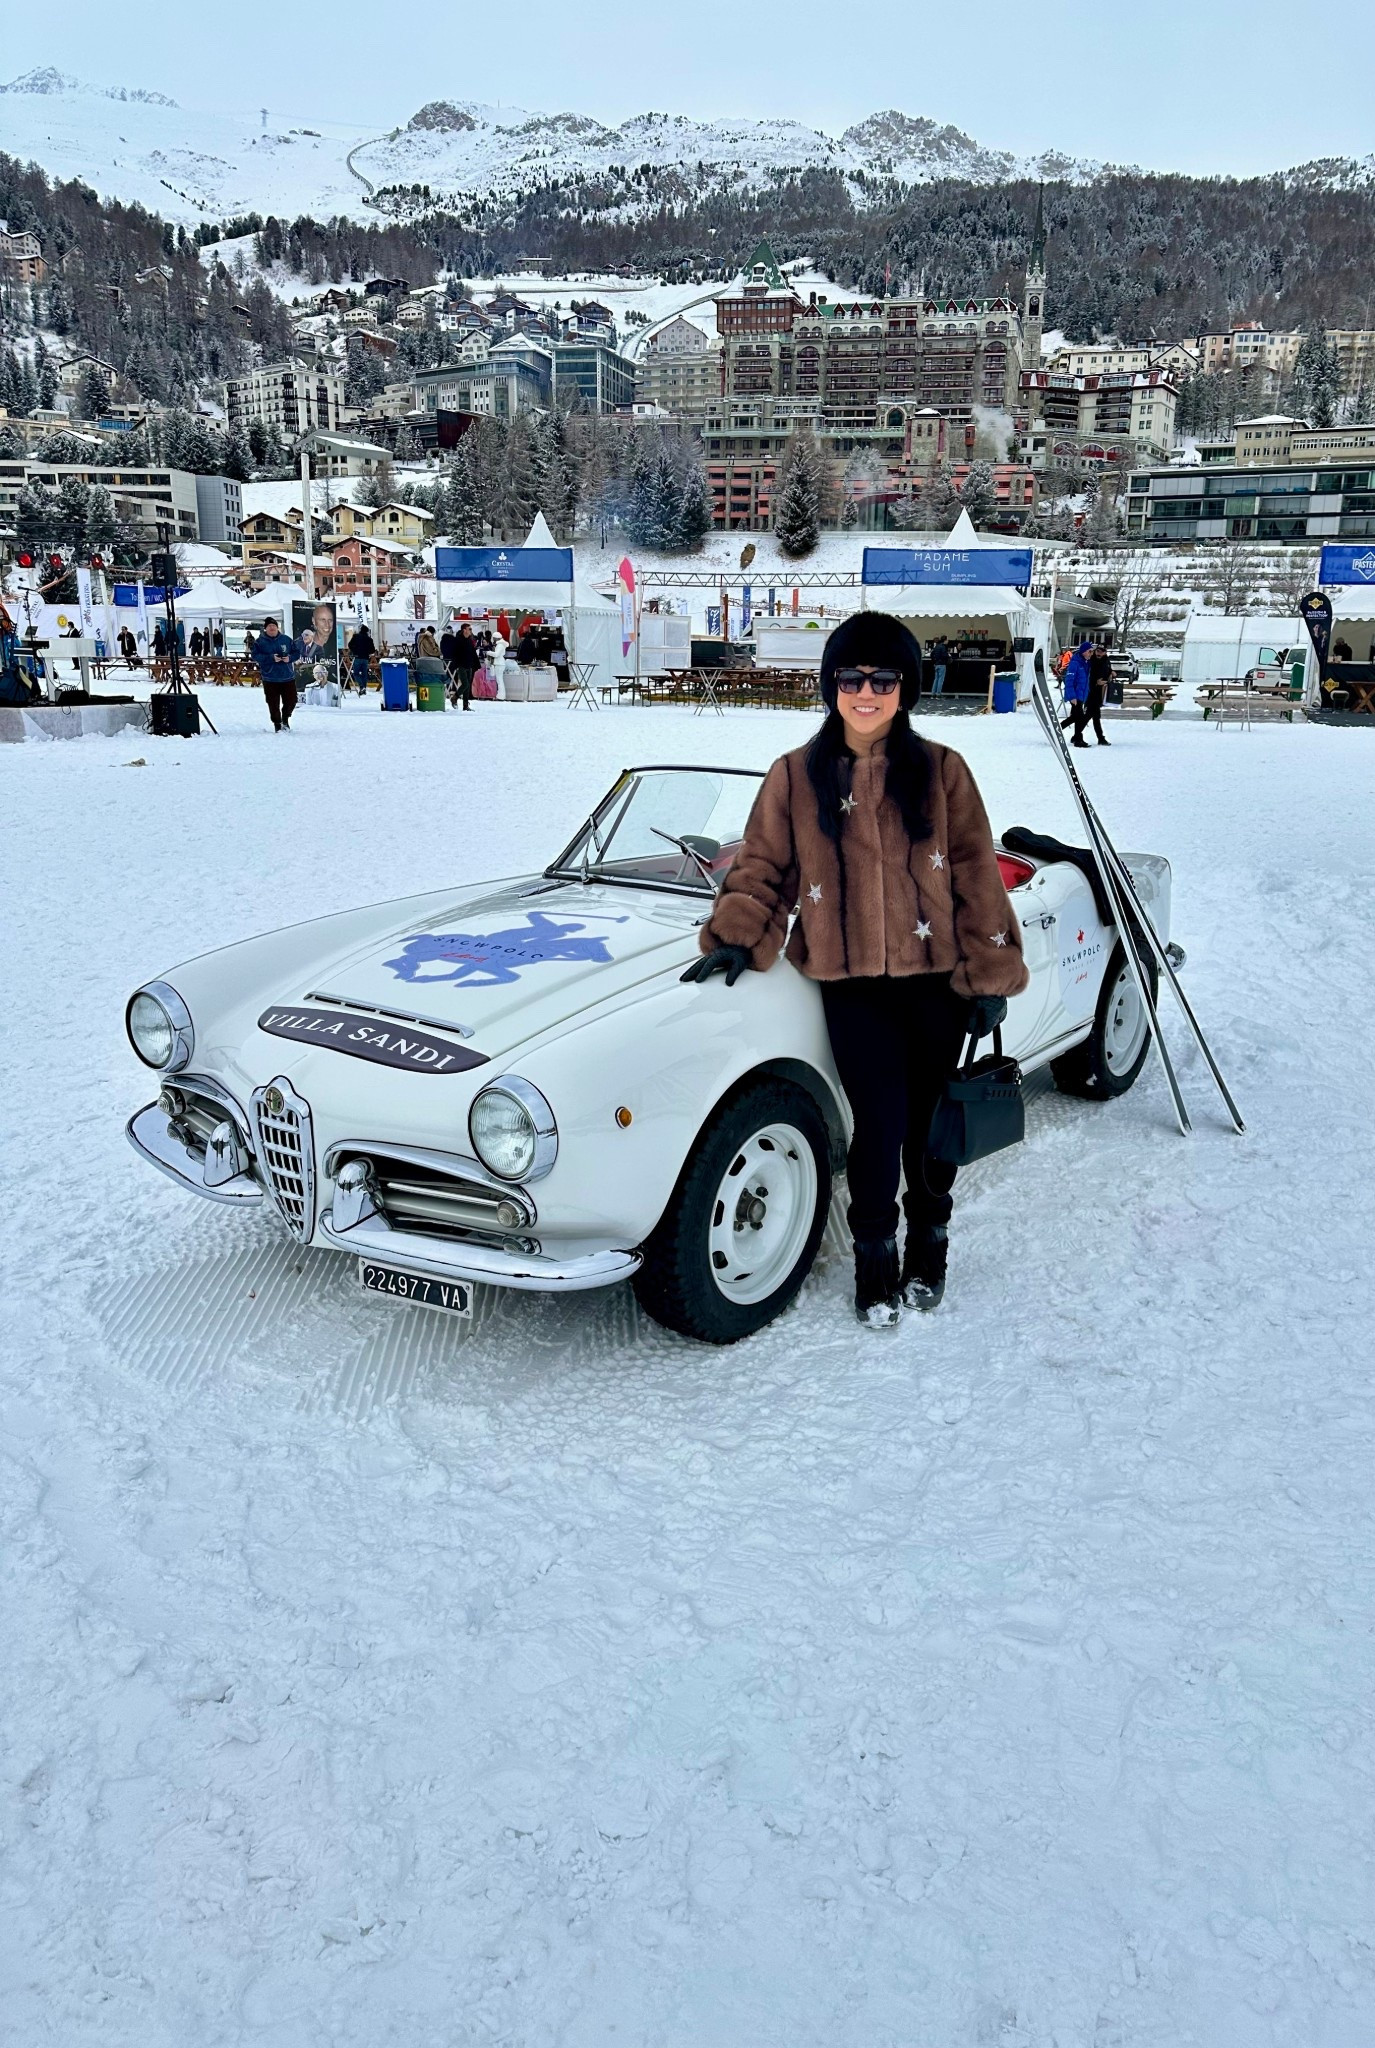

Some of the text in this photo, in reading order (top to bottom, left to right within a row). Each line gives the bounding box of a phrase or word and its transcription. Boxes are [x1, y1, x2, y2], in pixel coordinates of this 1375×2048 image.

[914, 552, 970, 562] MADAME
[491, 559, 515, 567] CRYSTAL
[923, 562, 951, 572] SUM
[263, 1013, 456, 1070] VILLA SANDI
[367, 1268, 461, 1309] 224977 VA
